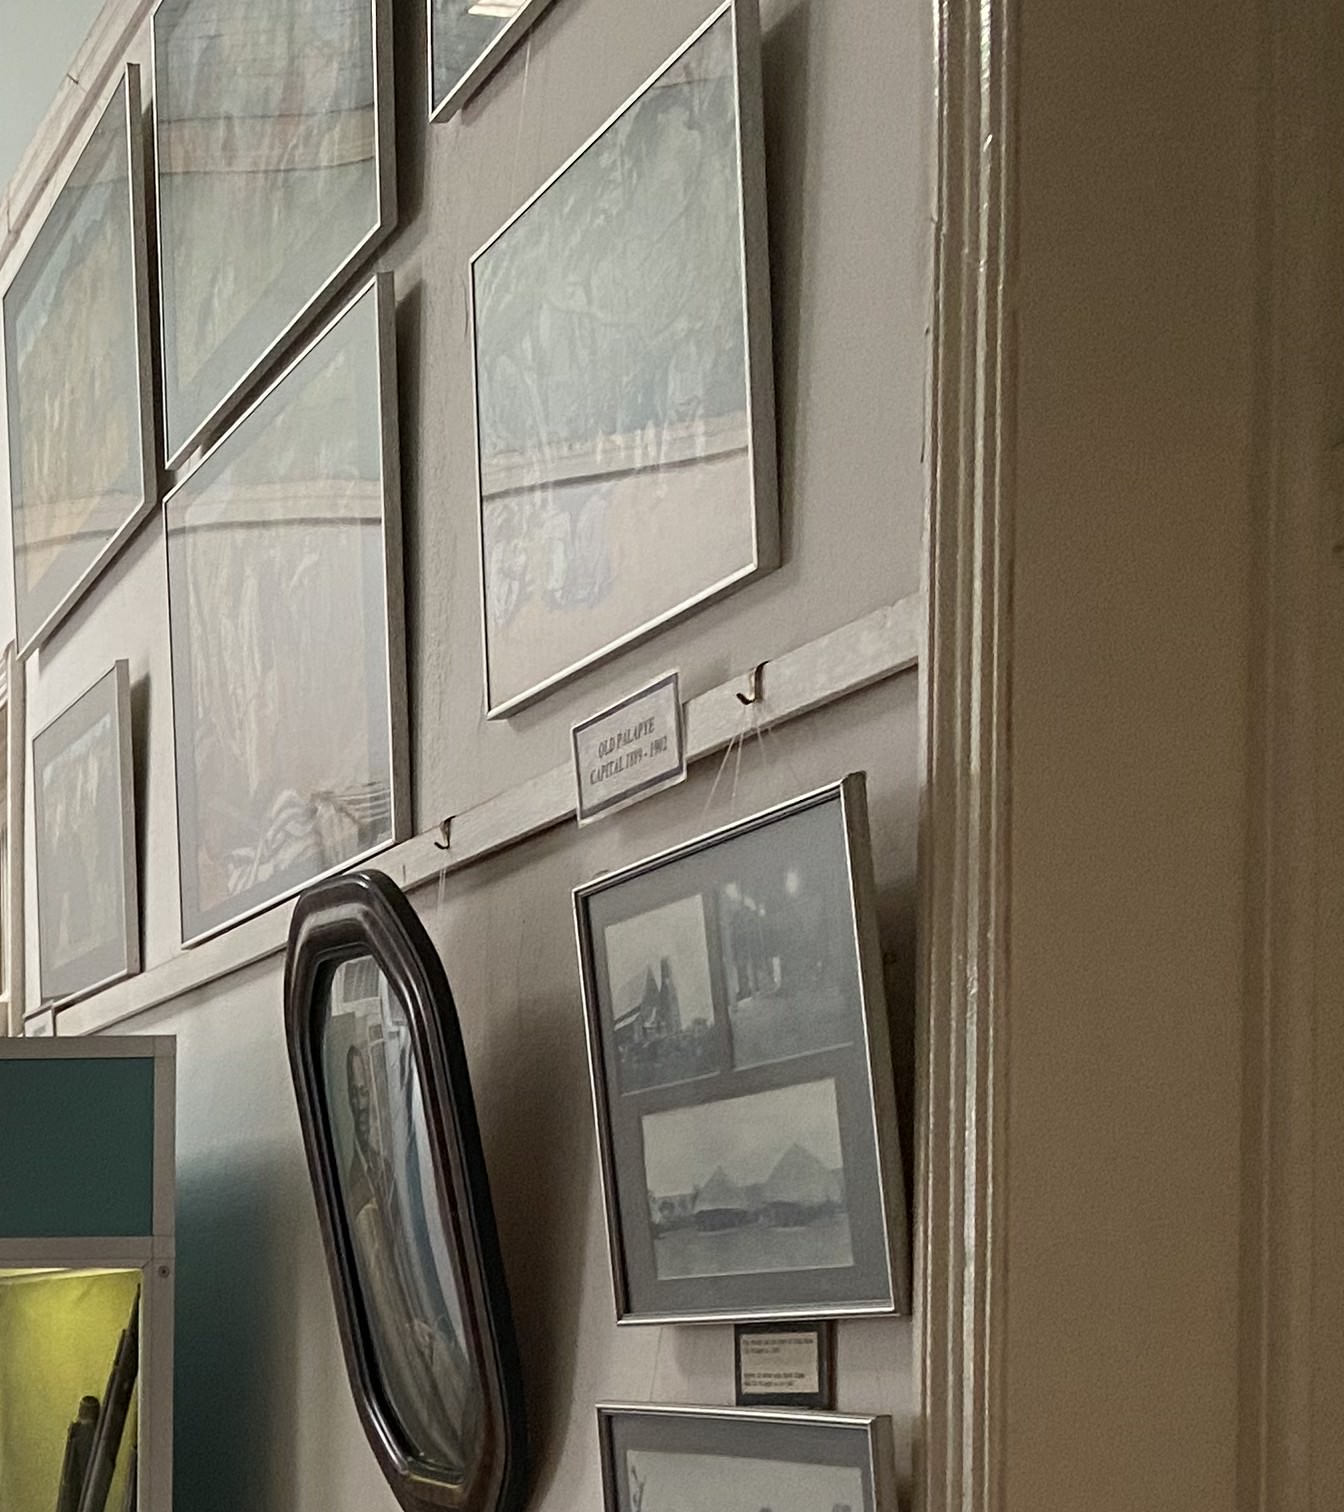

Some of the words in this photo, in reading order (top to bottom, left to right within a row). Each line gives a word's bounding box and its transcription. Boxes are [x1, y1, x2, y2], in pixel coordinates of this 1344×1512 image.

[598, 737, 616, 759] OLD
[616, 716, 655, 749] PALAPYE
[590, 756, 624, 784] CAPITAL
